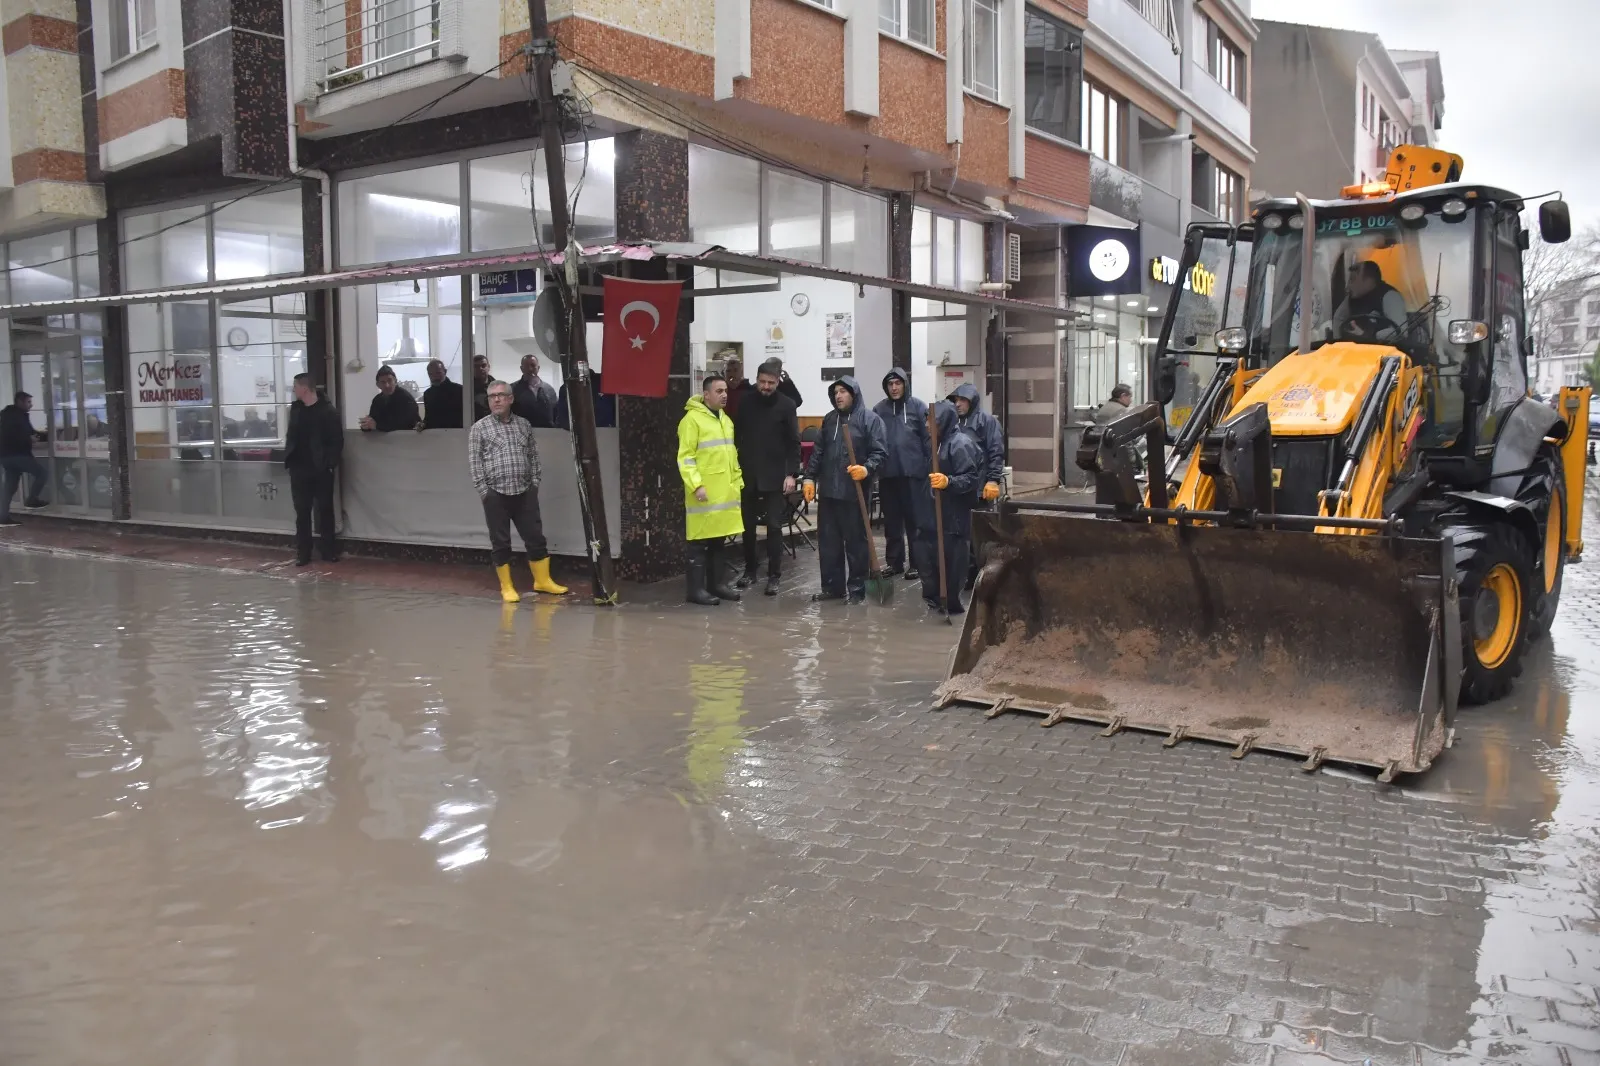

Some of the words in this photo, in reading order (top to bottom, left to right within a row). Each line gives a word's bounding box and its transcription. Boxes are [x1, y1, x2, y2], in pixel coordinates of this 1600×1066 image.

[1340, 218, 1362, 230] BB
[1368, 216, 1396, 228] 002
[481, 273, 508, 286] BAHÇE
[138, 360, 202, 387] Merkez
[139, 385, 204, 403] KIRAATHANESİ
